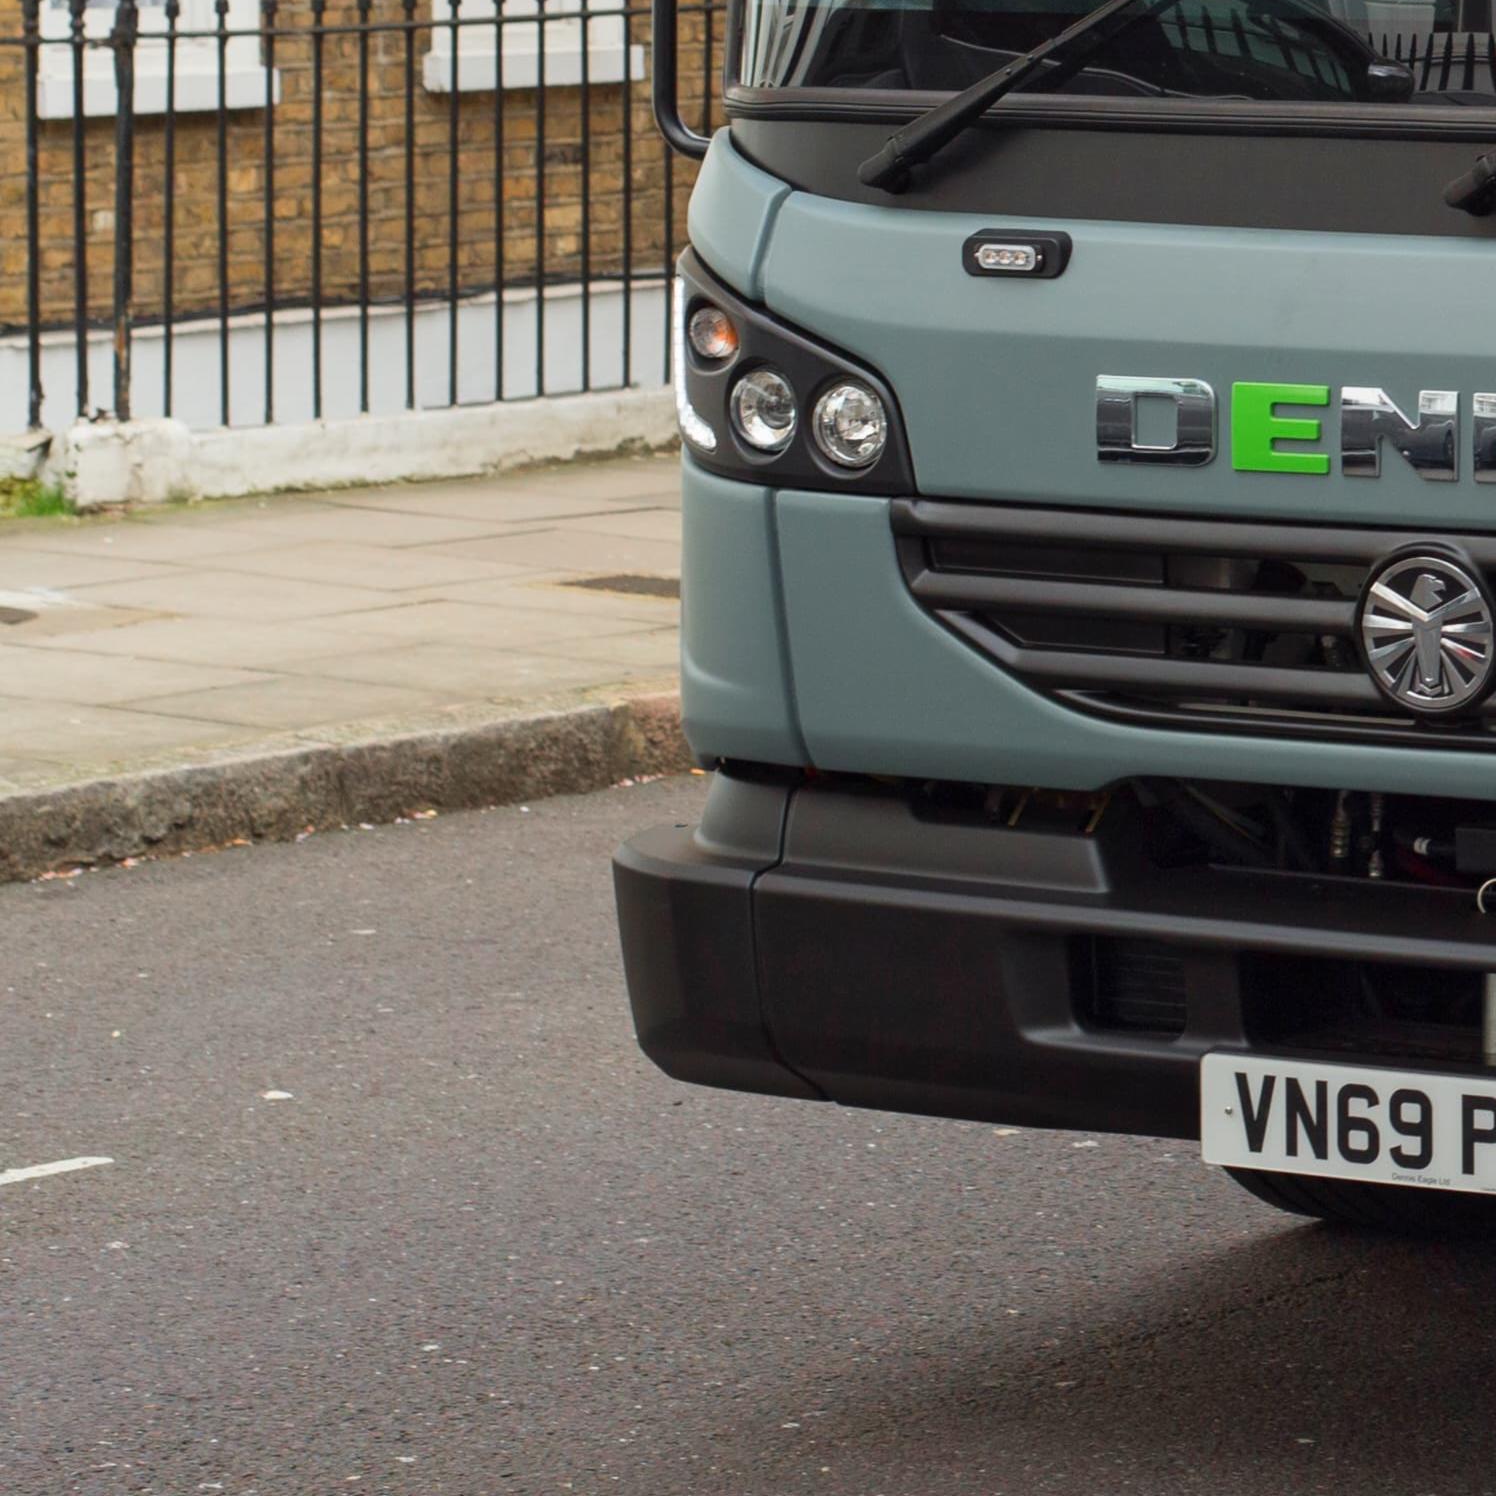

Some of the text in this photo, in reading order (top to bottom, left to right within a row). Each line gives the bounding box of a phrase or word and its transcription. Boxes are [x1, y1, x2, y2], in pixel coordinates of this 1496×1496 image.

[1234, 1070, 1434, 1172] VN69
[1391, 1171, 1452, 1187] Dennis Eagle Ltd
